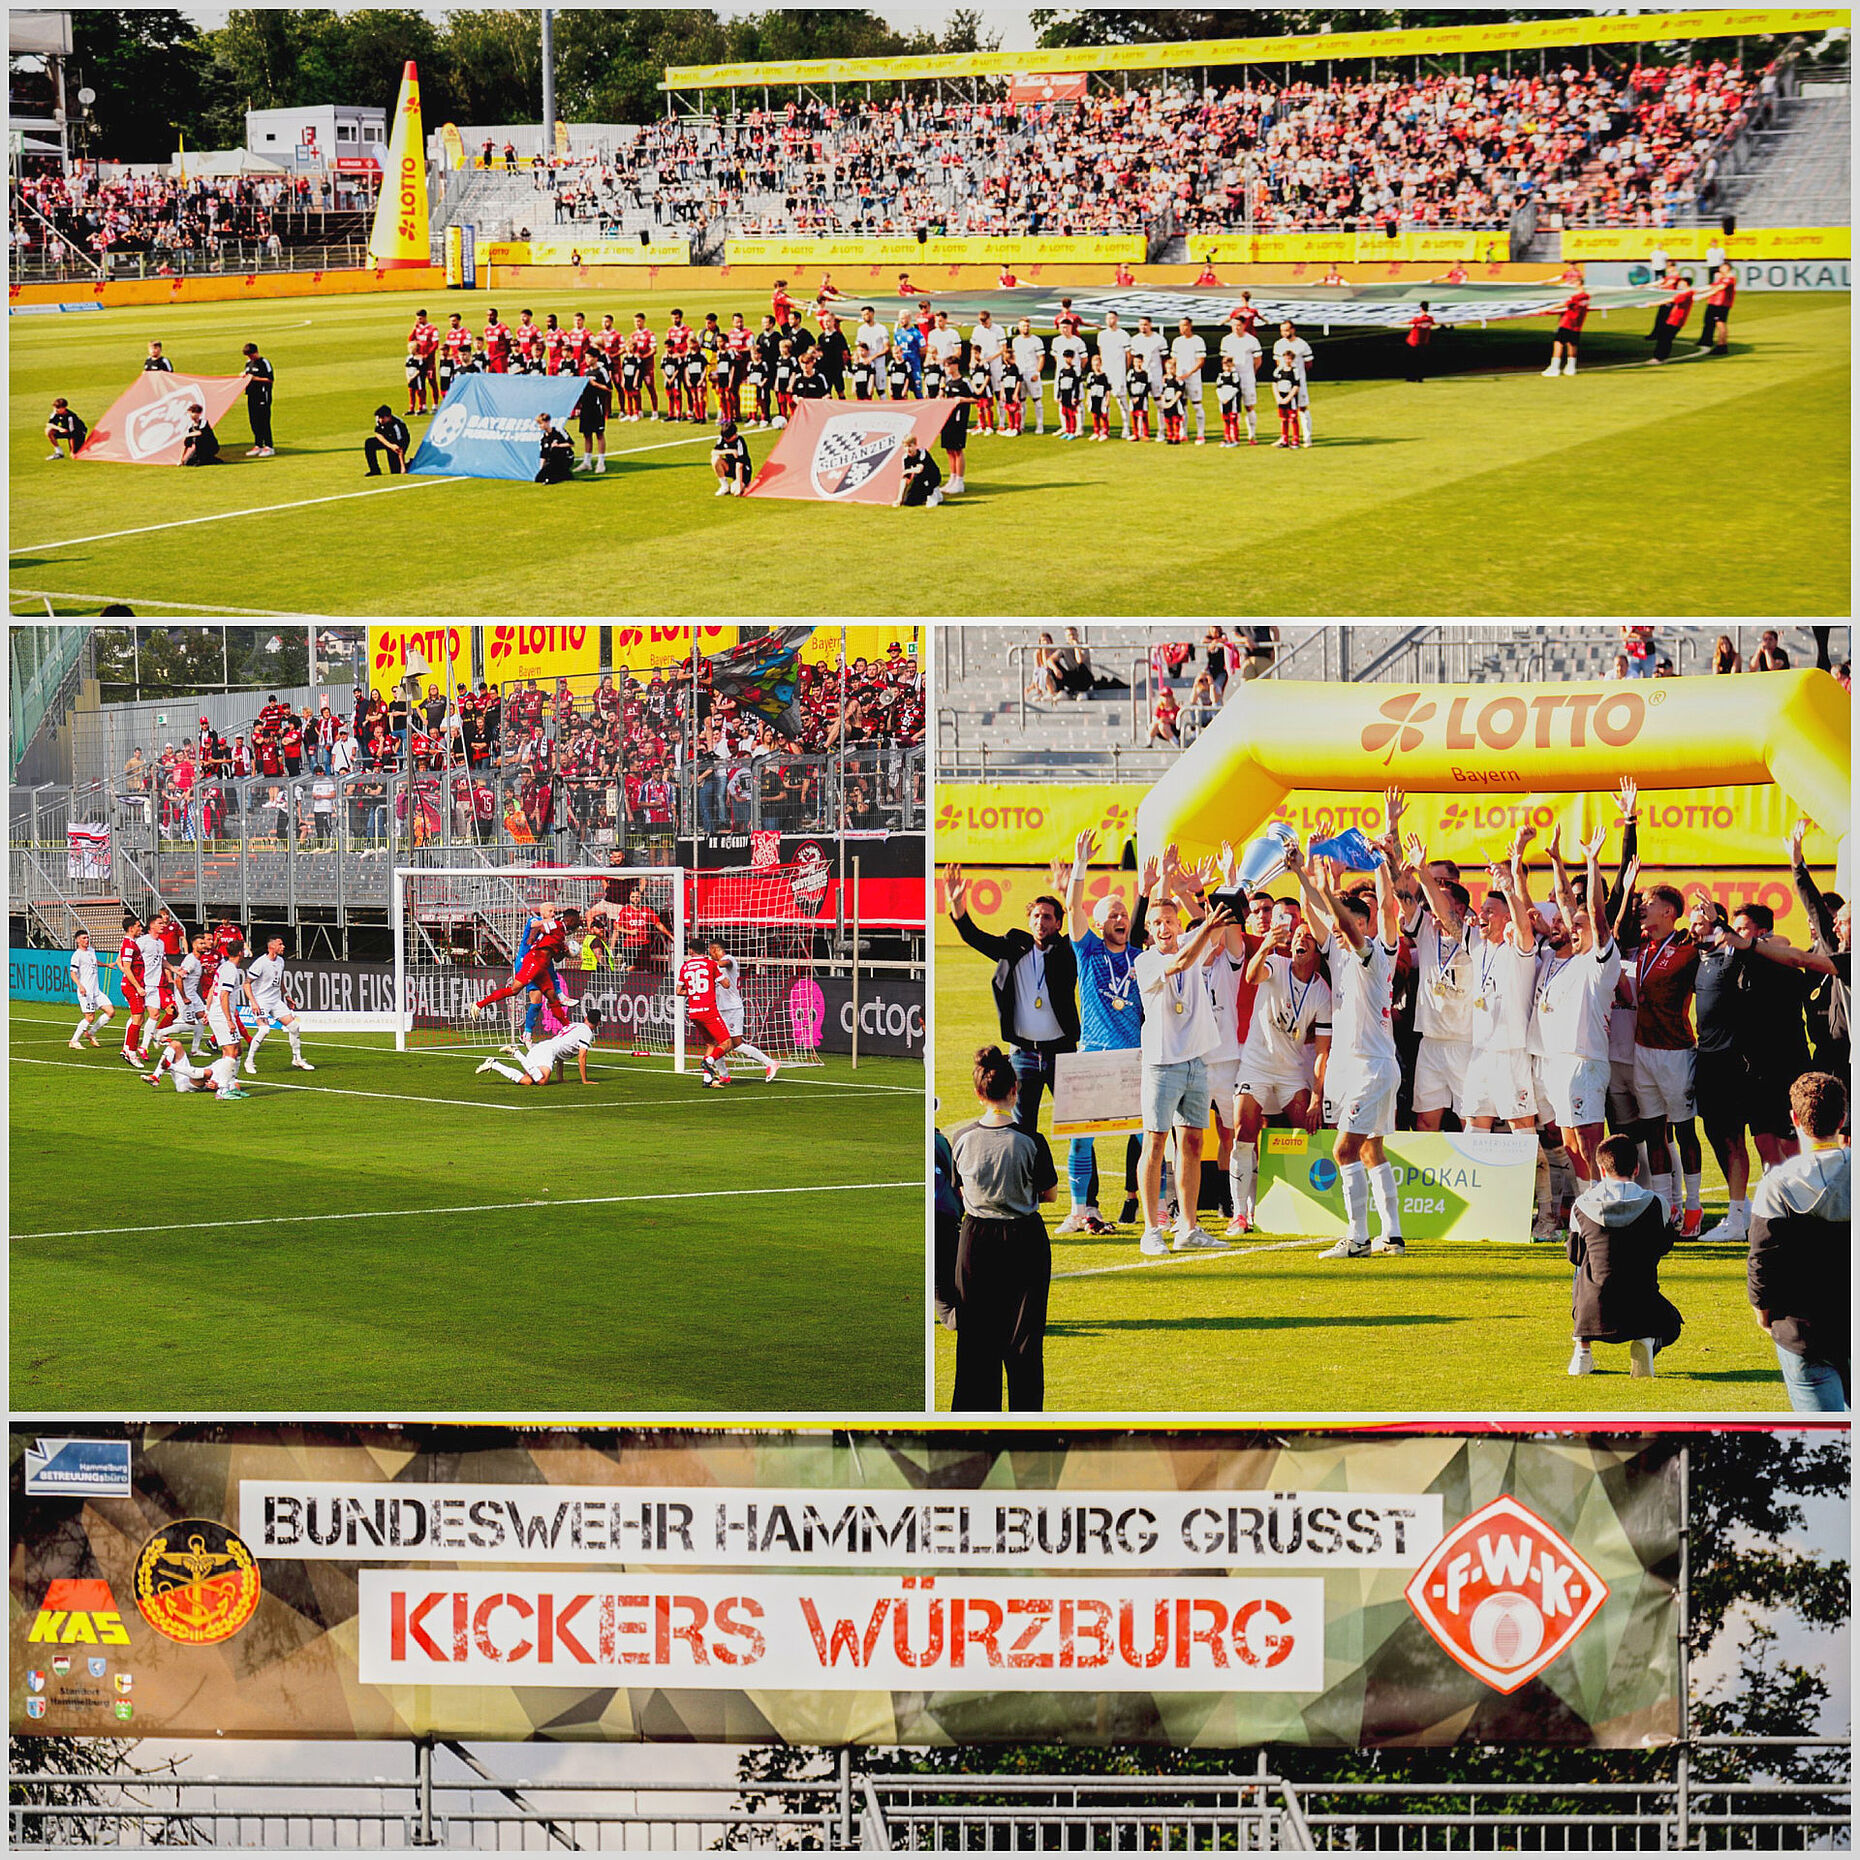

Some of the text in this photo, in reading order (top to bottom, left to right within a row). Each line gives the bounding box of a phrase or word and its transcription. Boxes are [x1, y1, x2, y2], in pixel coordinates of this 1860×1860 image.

[401, 157, 416, 216] LOTTO
[488, 248, 509, 256] LOTTO
[942, 244, 968, 253] LOTTO
[819, 434, 897, 471] SCHANZER
[812, 637, 843, 651] Bayern
[519, 665, 542, 678] Bayern
[650, 653, 675, 667] Bayern
[1446, 691, 1646, 750] LOTTO
[1451, 766, 1521, 786] Bayern
[482, 795, 493, 812] 15
[968, 806, 1044, 830] LOTTO
[1302, 806, 1382, 830] LOTTO
[1473, 805, 1554, 829] LOTTO
[1649, 805, 1734, 829] LOTTO
[1680, 881, 1794, 921] OTTO
[9, 962, 26, 990] EN
[683, 968, 709, 996] 36
[319, 971, 353, 1011] DER
[359, 973, 497, 1022] FUSBALLFANS
[581, 987, 676, 1034] octopus
[840, 995, 924, 1049] octop
[1281, 1138, 1303, 1147] LOTTO
[1391, 1166, 1482, 1188] OPOKAL
[1403, 1197, 1446, 1214] 2024
[40, 1470, 128, 1482] BETREUUNGsbüro
[80, 1462, 128, 1474] Hammelburg
[263, 1491, 1417, 1556] BUNDESWEHR HAMMELBURG GRÜSST
[27, 1610, 132, 1646] KAS
[389, 1576, 1296, 1669] KICKERS WÜRZBURG
[50, 1696, 110, 1708] Hammelburg
[59, 1686, 100, 1695] Standort
